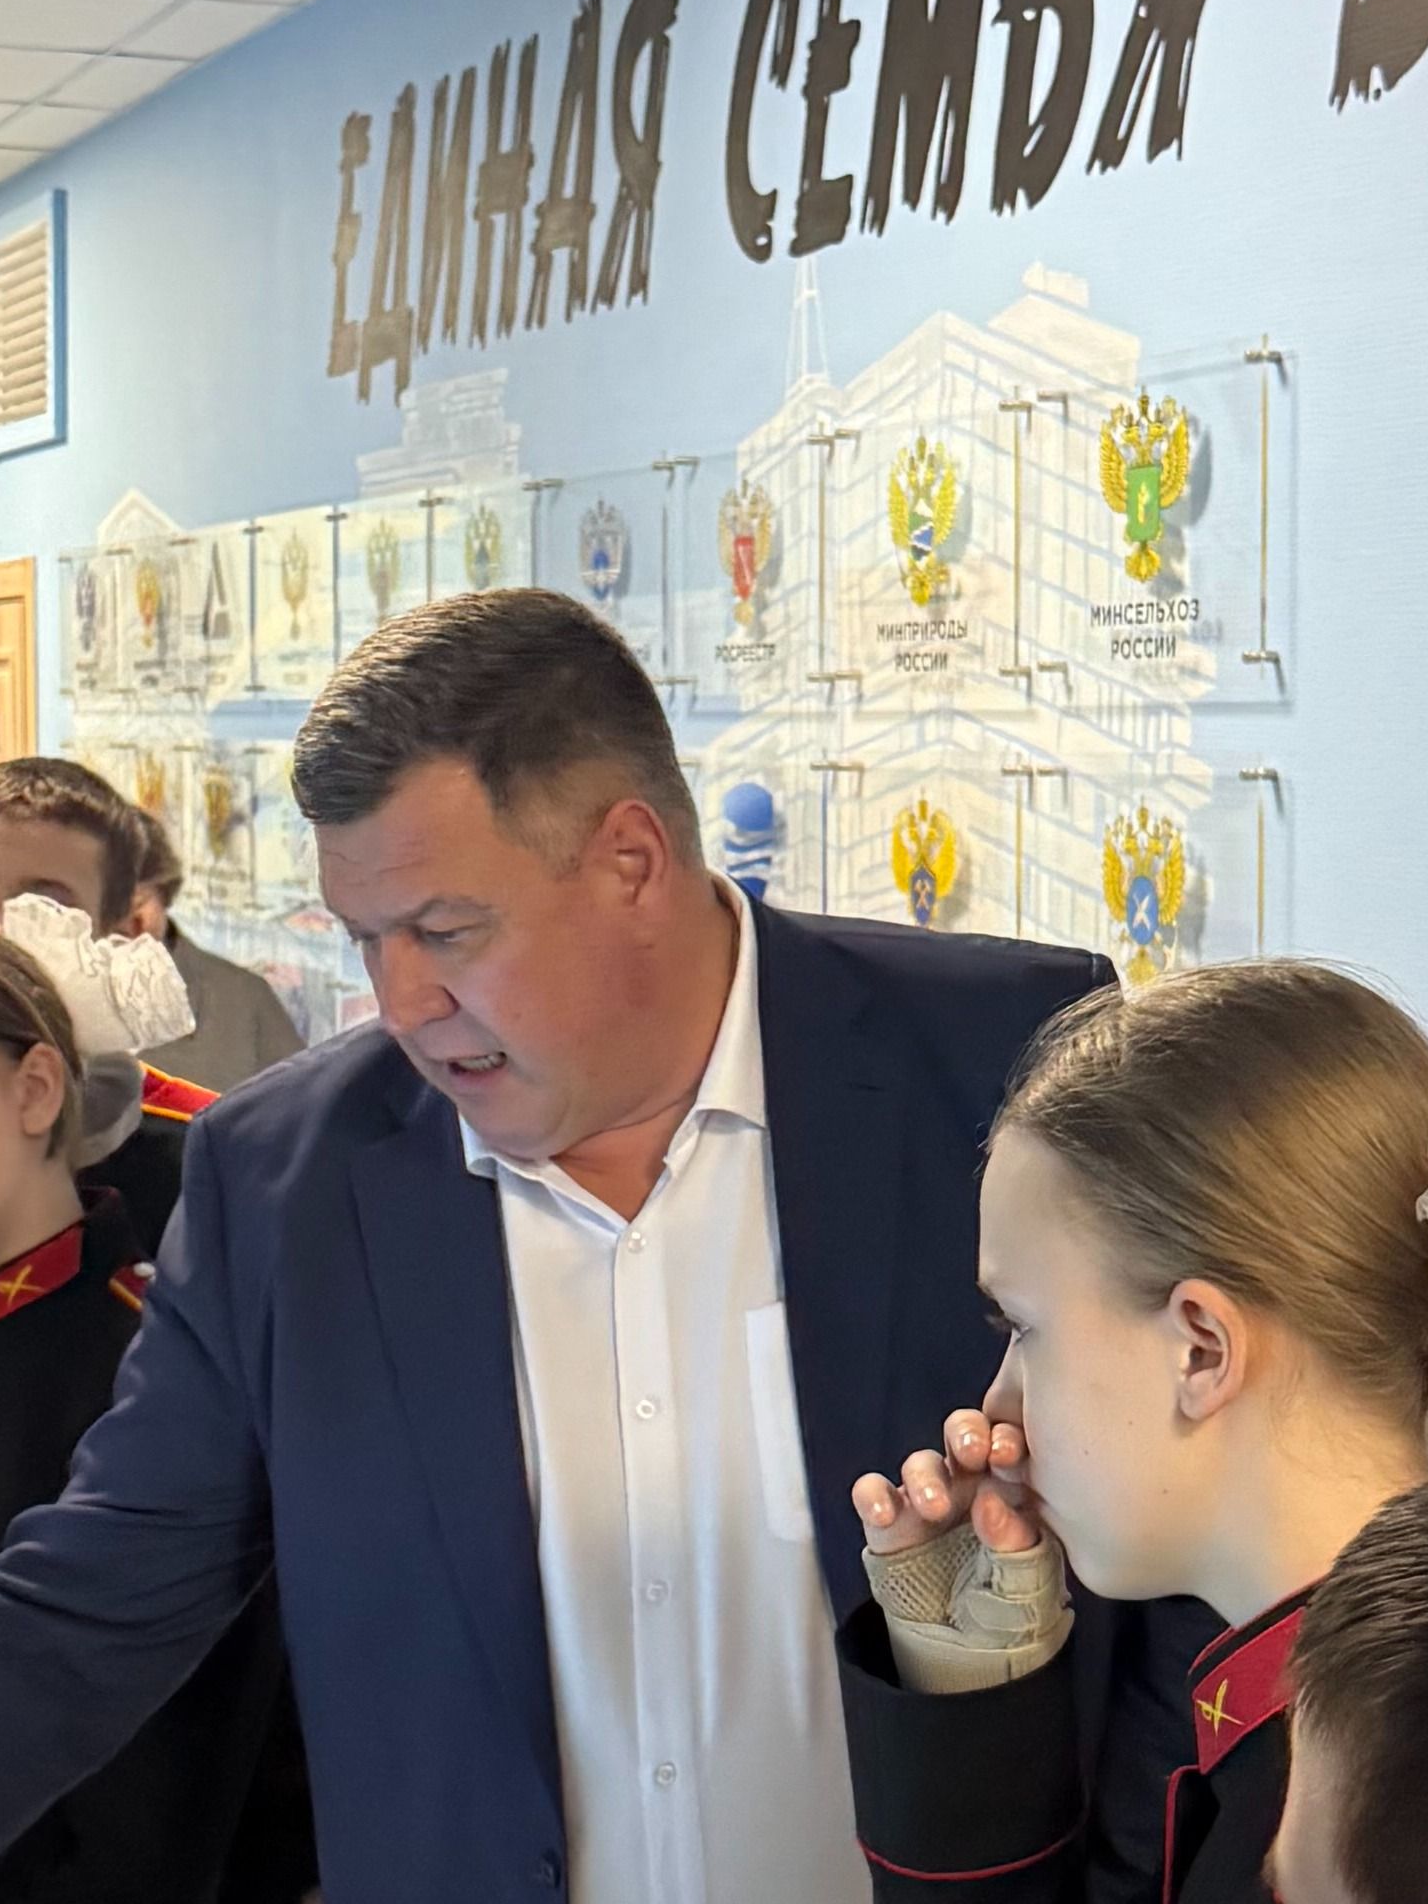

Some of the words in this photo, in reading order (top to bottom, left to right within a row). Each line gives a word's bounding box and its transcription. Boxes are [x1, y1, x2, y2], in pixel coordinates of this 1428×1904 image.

[1090, 598, 1200, 627] МИНСЕЛЬХОЗ
[877, 619, 968, 643] МИНПРИРОДЫ
[1111, 636, 1177, 661] РОССИИ
[895, 652, 948, 672] РОССИИ
